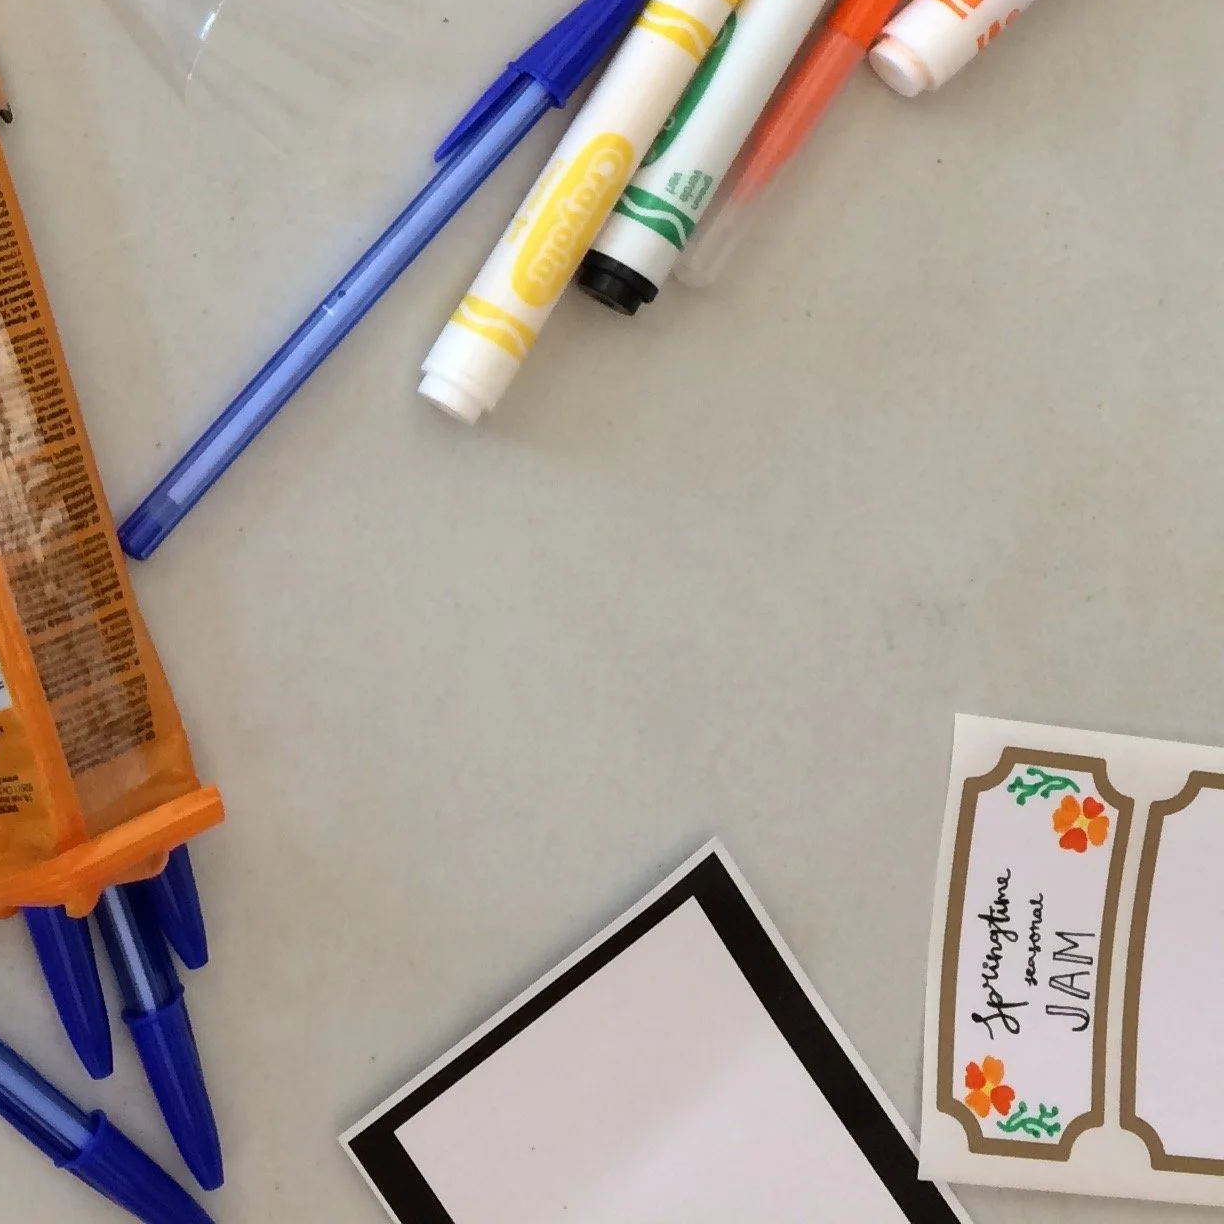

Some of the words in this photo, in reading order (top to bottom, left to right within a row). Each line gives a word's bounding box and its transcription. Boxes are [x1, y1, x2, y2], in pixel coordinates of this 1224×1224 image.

[521, 142, 628, 291] Crayola
[971, 868, 1029, 1040] Springtime
[1025, 893, 1044, 987] seasonal
[1045, 931, 1096, 1032] JAM
